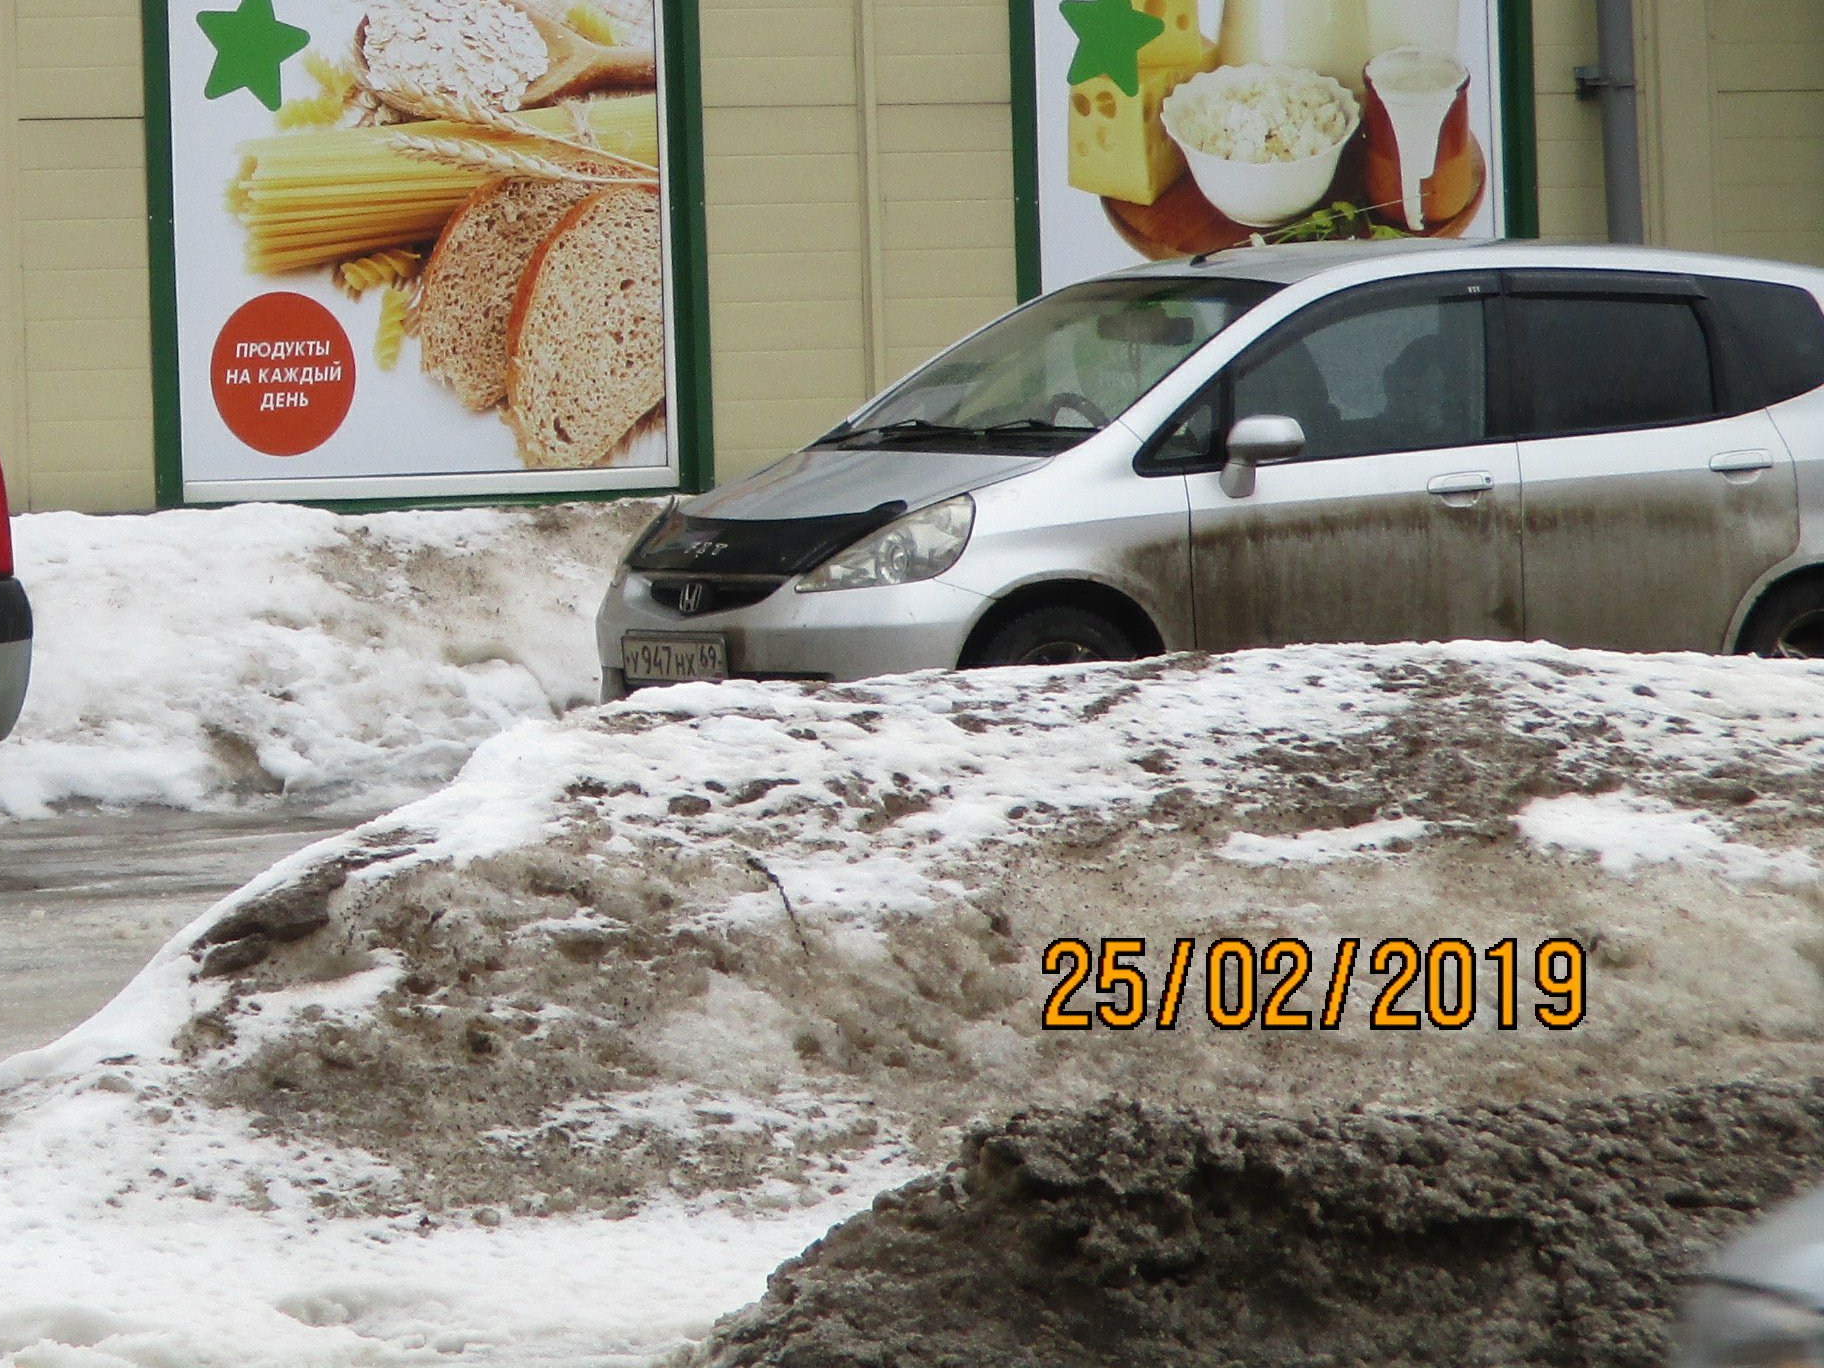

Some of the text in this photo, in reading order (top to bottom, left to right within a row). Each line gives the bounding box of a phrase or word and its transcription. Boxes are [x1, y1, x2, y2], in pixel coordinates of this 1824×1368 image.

[235, 340, 330, 360] ПРОДУКТЫ
[226, 360, 342, 385] НА КАЖДЫЙ
[259, 391, 309, 411] ДЕНЬ
